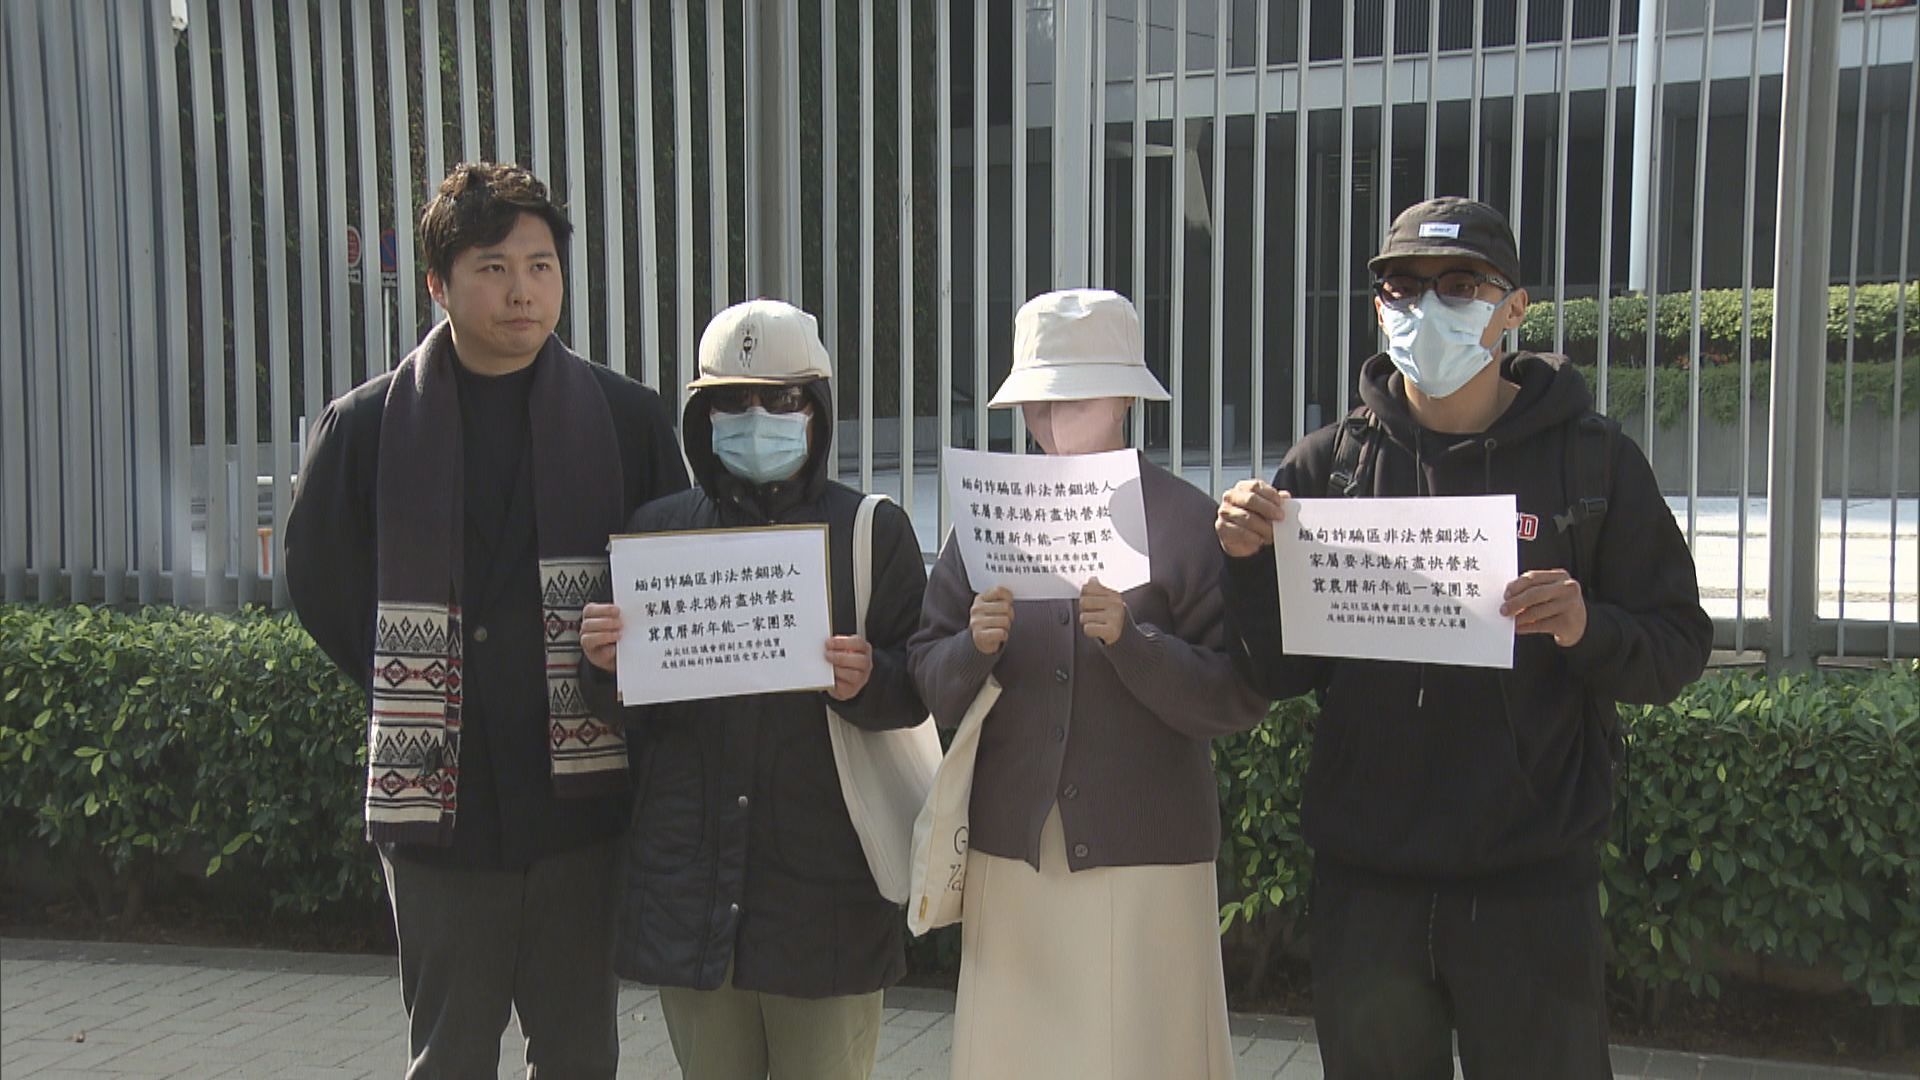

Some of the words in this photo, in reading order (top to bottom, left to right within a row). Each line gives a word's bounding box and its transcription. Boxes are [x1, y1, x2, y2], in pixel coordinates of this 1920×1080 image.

[962, 476, 1116, 497] 緬甸詐騙區非法禁錮港人
[970, 502, 1112, 522] 家屬要求港府盡快營救
[1299, 527, 1488, 544] 緬甸詐騙區非法禁錮港人
[1516, 512, 1539, 541] D
[1309, 553, 1481, 572] 家屬要求港府盡快營救
[635, 563, 801, 592] 緬甸詐騙區非法禁錮港人
[1312, 578, 1481, 598] 冀農曆新年能一家團聚
[645, 589, 795, 617] 家屬要求港府盡快營救
[648, 614, 797, 642] 冀農曆新年能一家團聚
